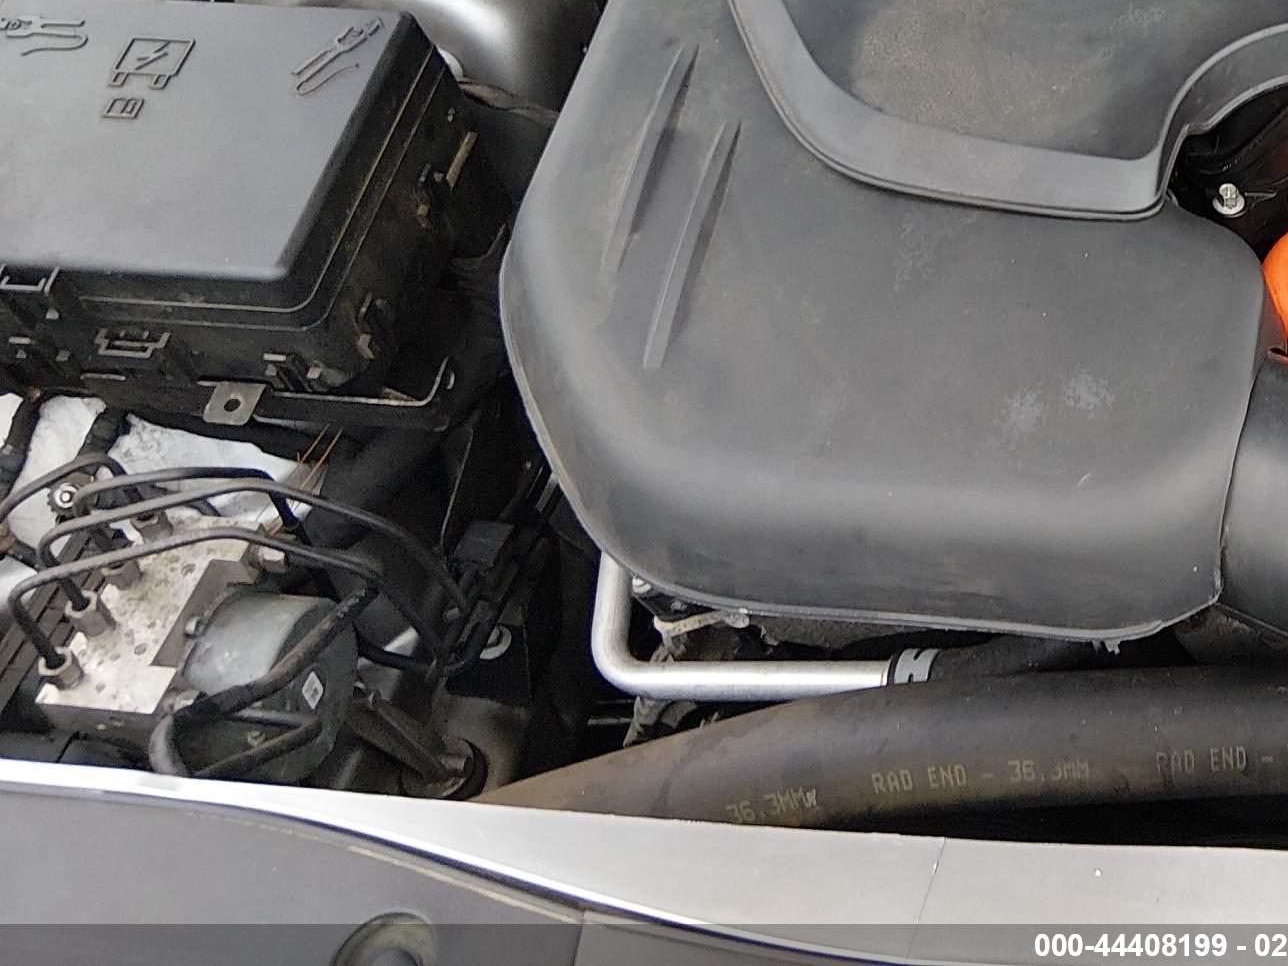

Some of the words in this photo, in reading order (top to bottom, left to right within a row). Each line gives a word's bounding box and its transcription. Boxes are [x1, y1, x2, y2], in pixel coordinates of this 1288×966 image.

[1209, 745, 1248, 772] END
[871, 768, 914, 795] RAD
[927, 763, 968, 789] END
